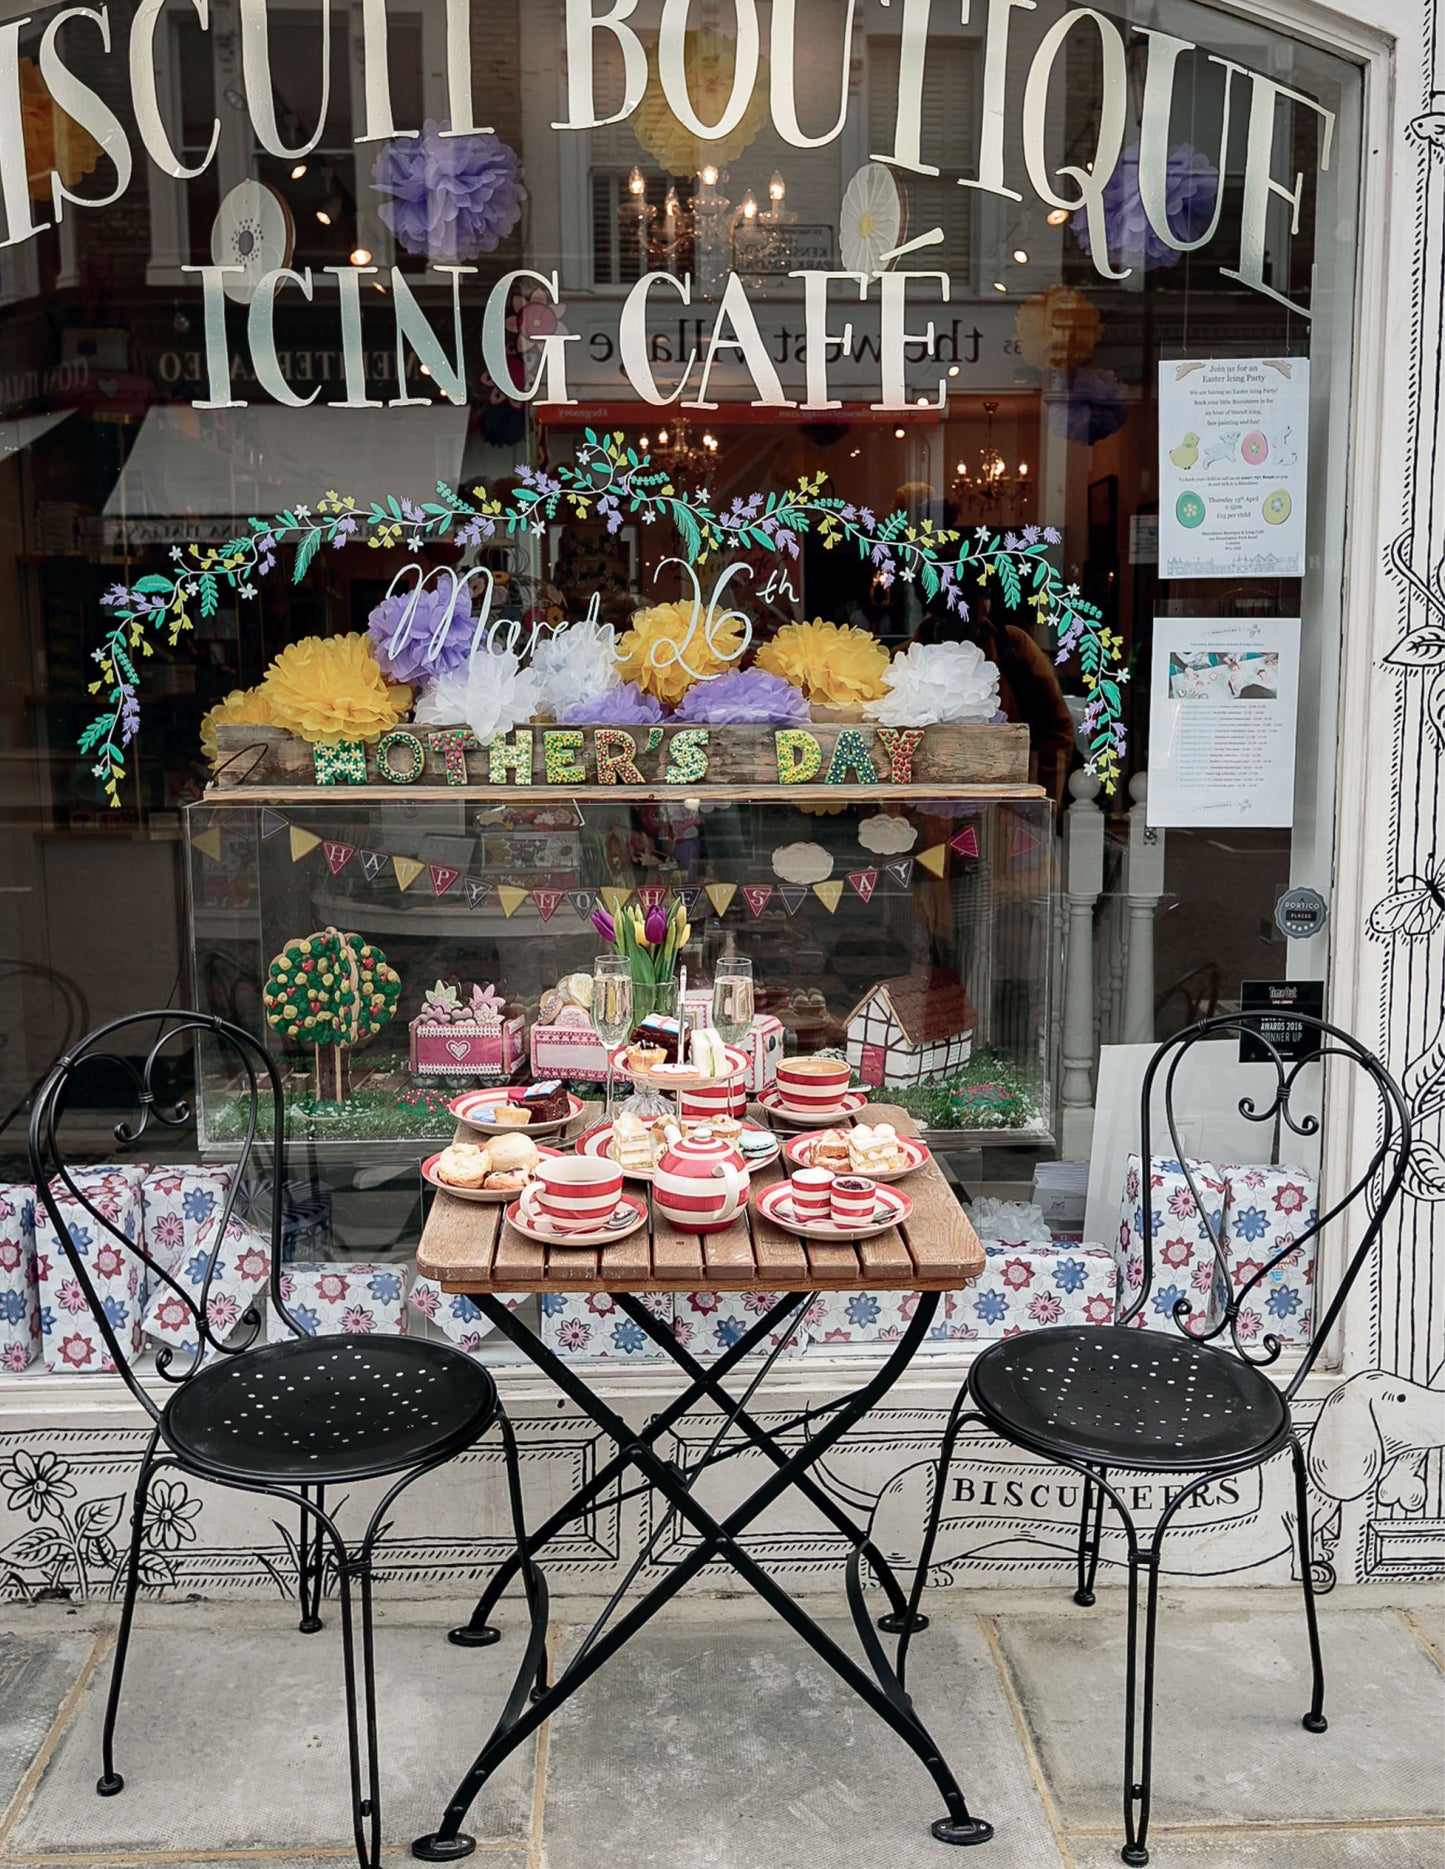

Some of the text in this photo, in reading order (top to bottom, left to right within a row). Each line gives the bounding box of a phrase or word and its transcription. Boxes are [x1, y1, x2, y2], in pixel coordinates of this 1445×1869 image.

[181, 228, 952, 412] ICING CAFÉ
[1246, 375, 1265, 383] Party
[386, 563, 632, 663] March
[312, 727, 926, 785] MOTHER'S DAY
[329, 845, 487, 900] HAPPY
[1285, 902, 1320, 910] PORTICO
[1261, 1022, 1303, 1031] AWARDS 2016
[1292, 1032, 1303, 1042] UP
